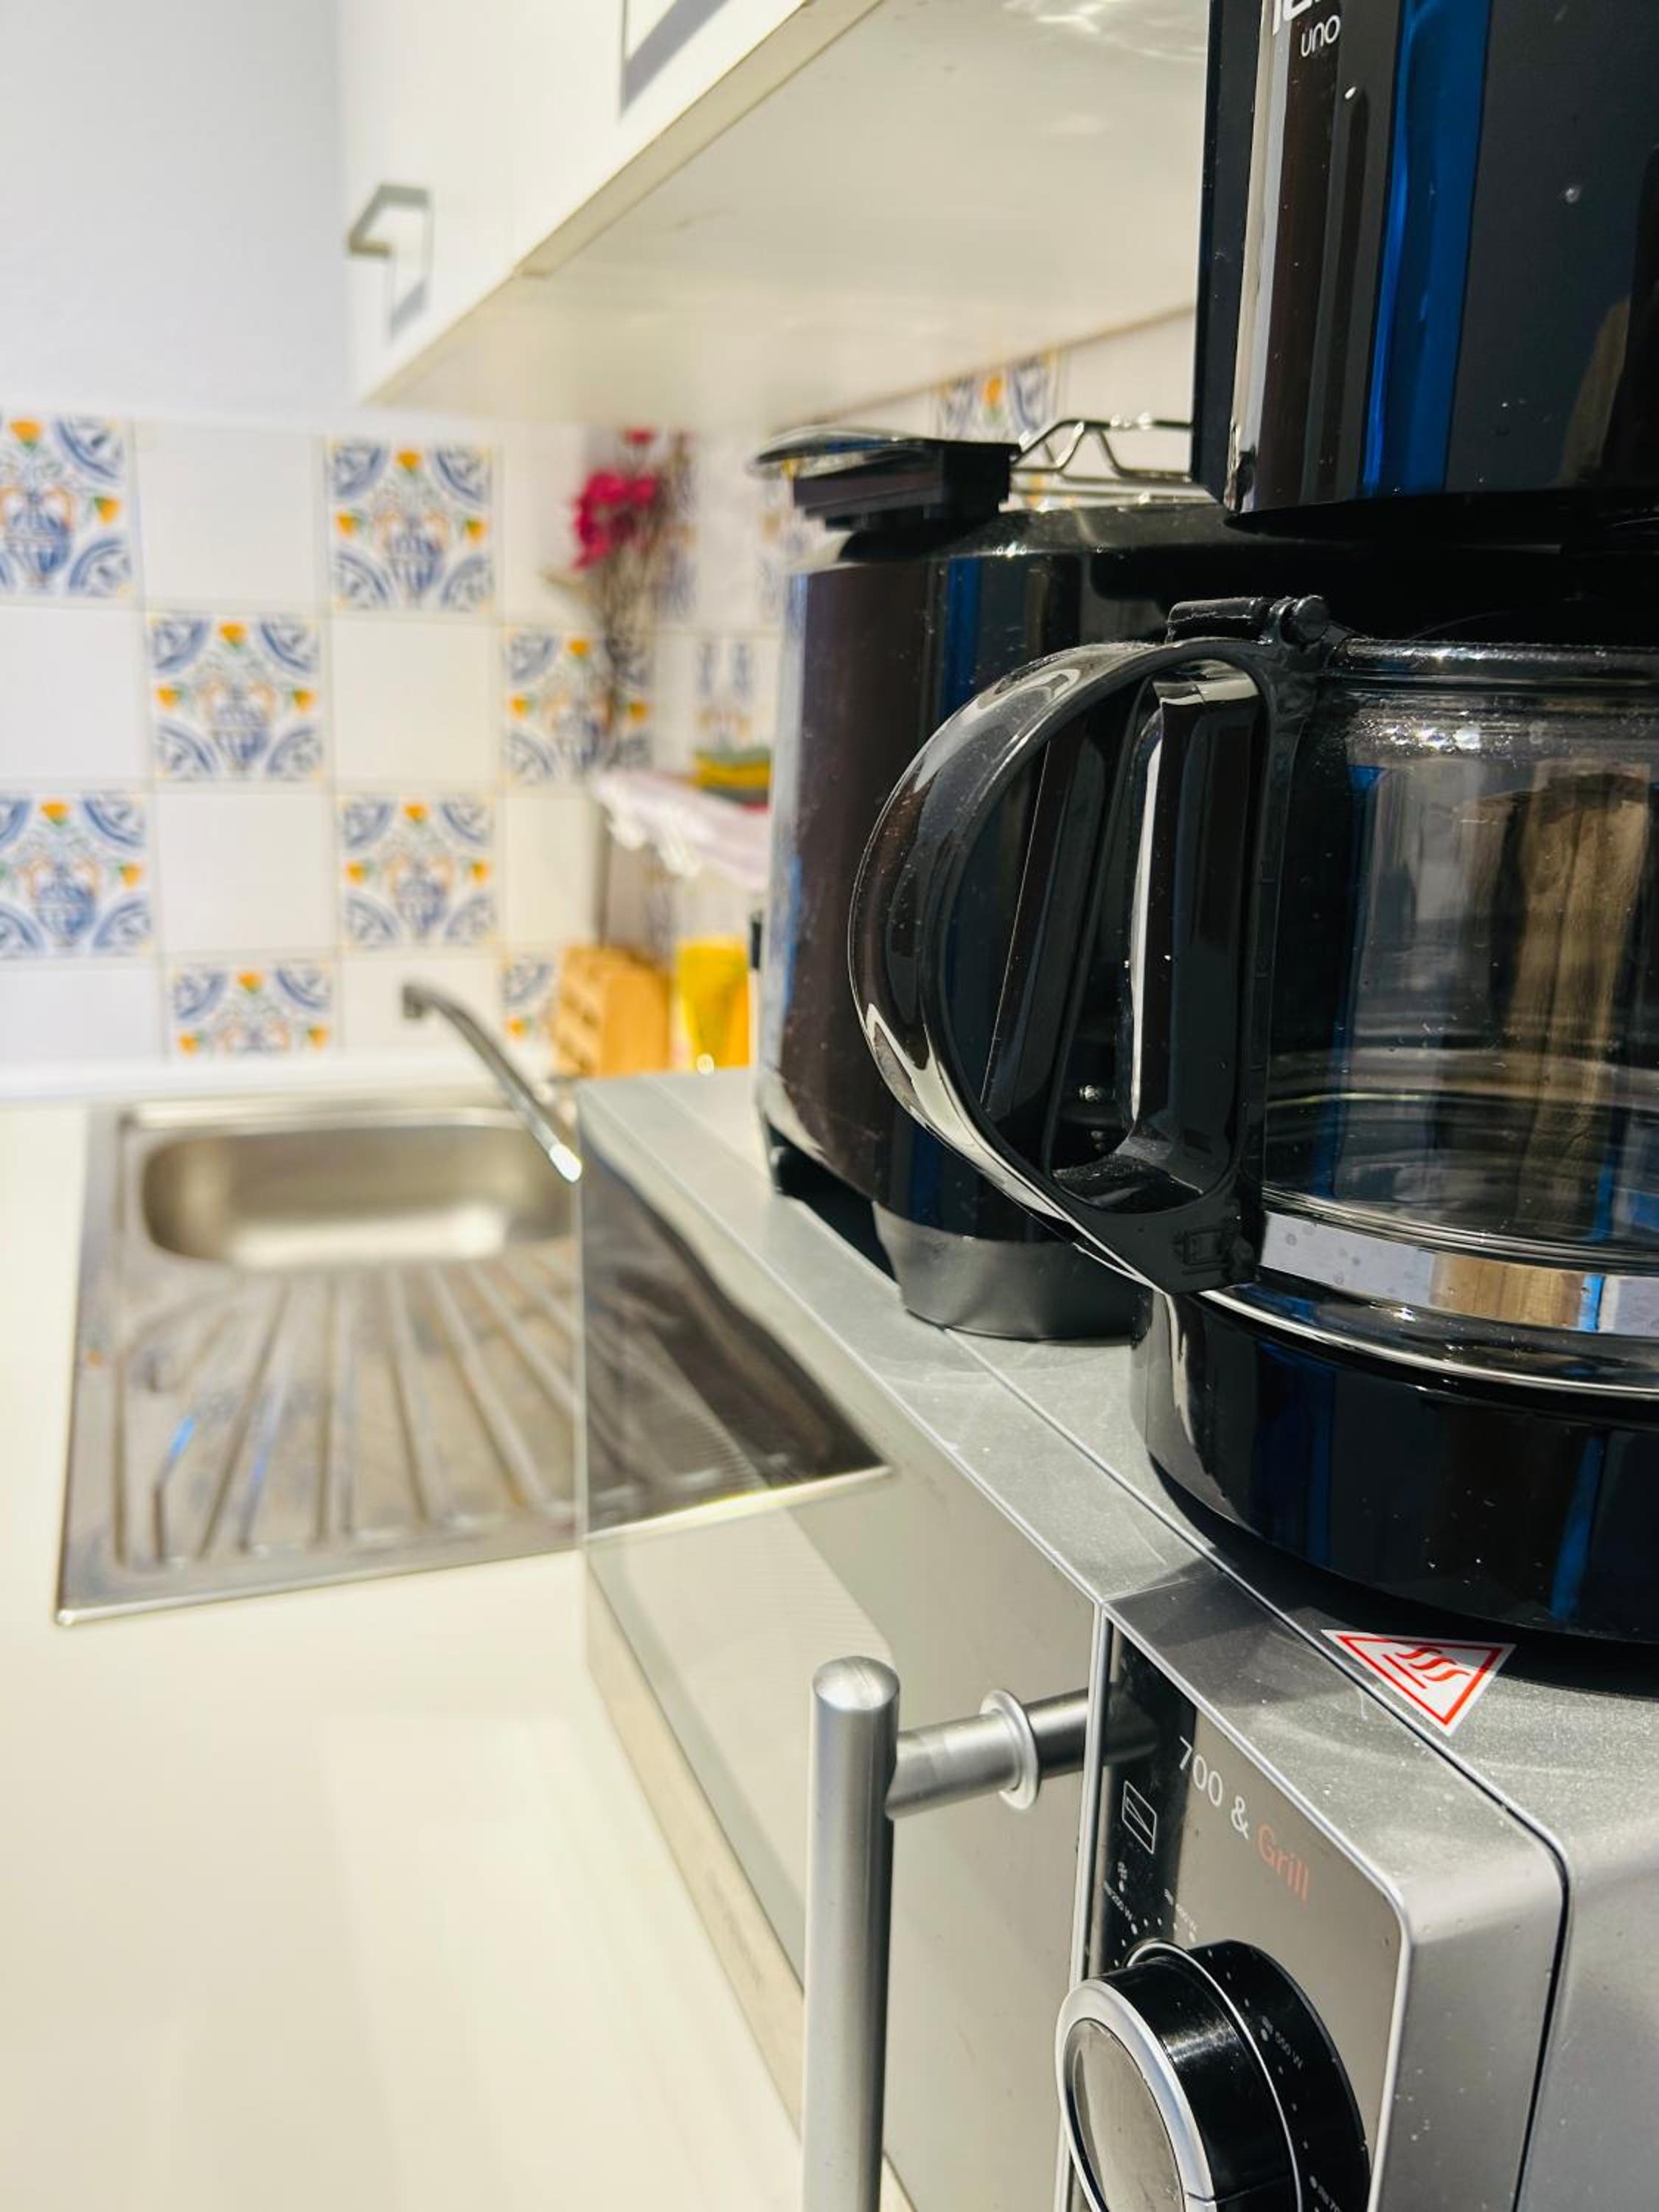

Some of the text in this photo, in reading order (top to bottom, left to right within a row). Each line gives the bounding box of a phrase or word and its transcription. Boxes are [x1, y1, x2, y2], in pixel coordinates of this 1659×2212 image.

[1301, 15, 1341, 58] uno
[1180, 1736, 1310, 1902] 700 & Grill
